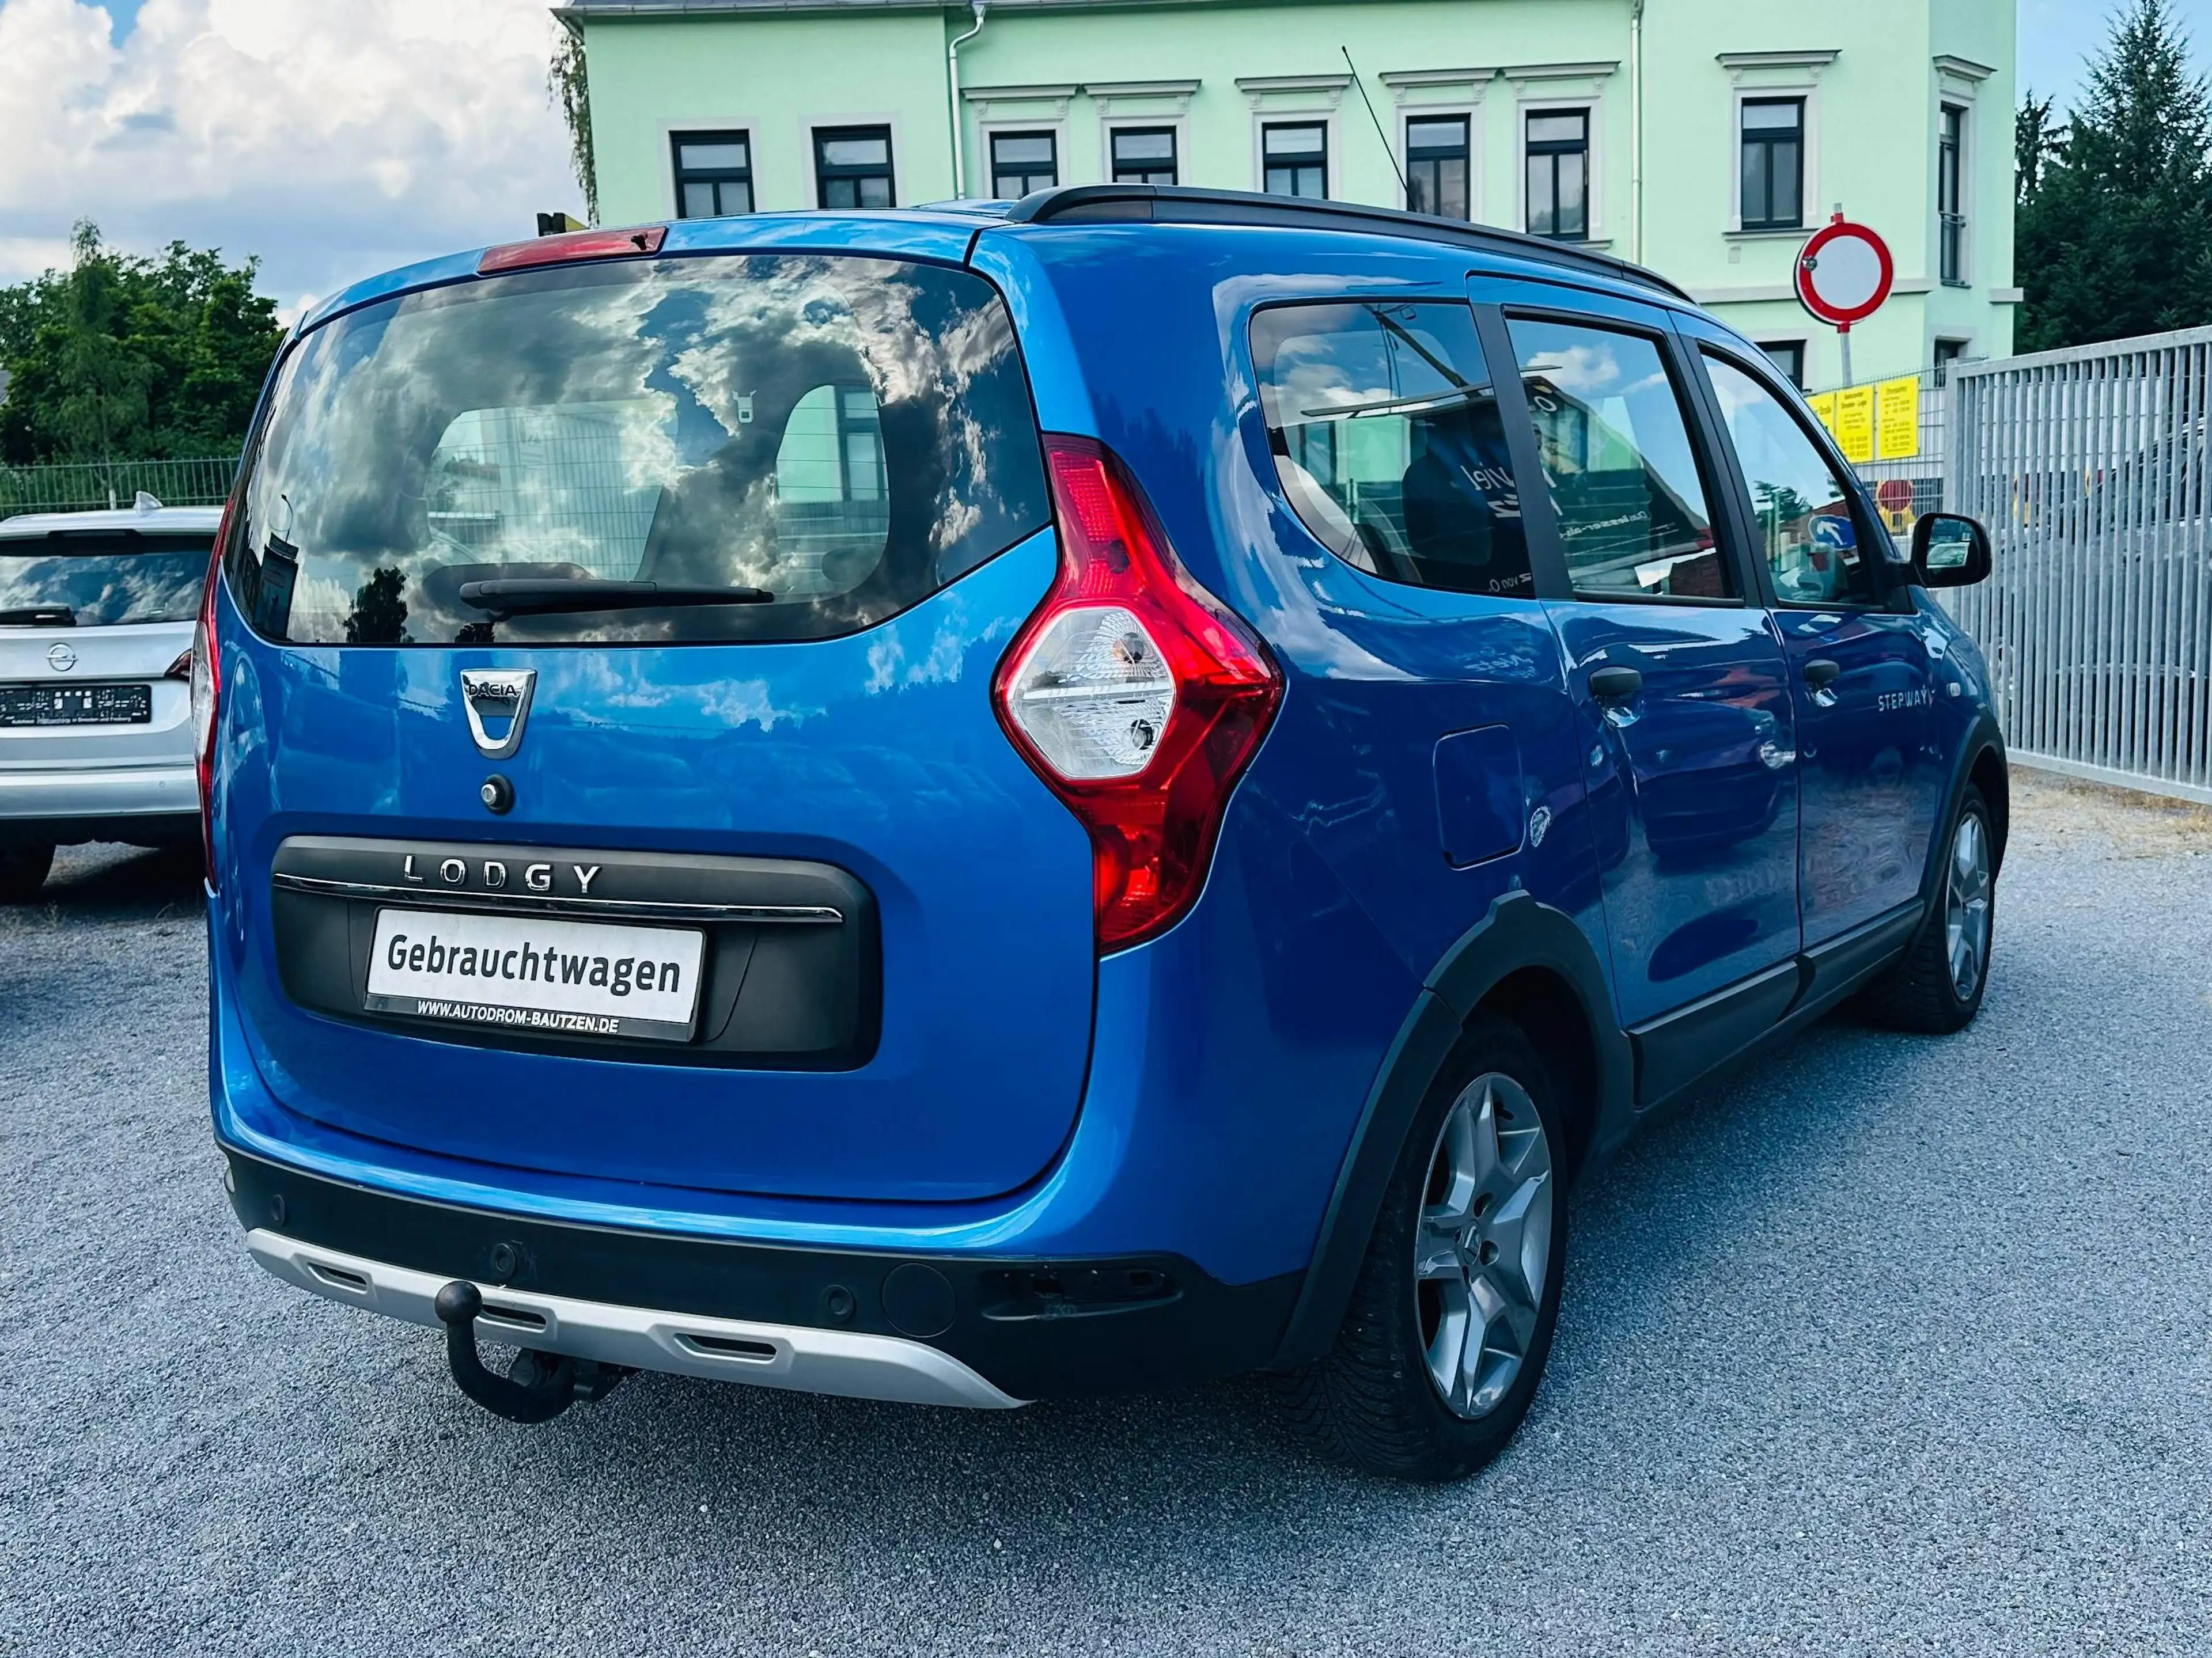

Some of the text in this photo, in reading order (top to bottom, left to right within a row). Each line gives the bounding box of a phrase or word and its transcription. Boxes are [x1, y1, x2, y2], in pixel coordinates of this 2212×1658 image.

[468, 682, 518, 697] DACIA
[1878, 688, 1926, 712] STEPWAY
[403, 855, 602, 894] LODGY
[388, 933, 680, 997] Gebrauchtwagen
[417, 1000, 620, 1034] WWW.AUTODROM-BAUTZEN.DE
